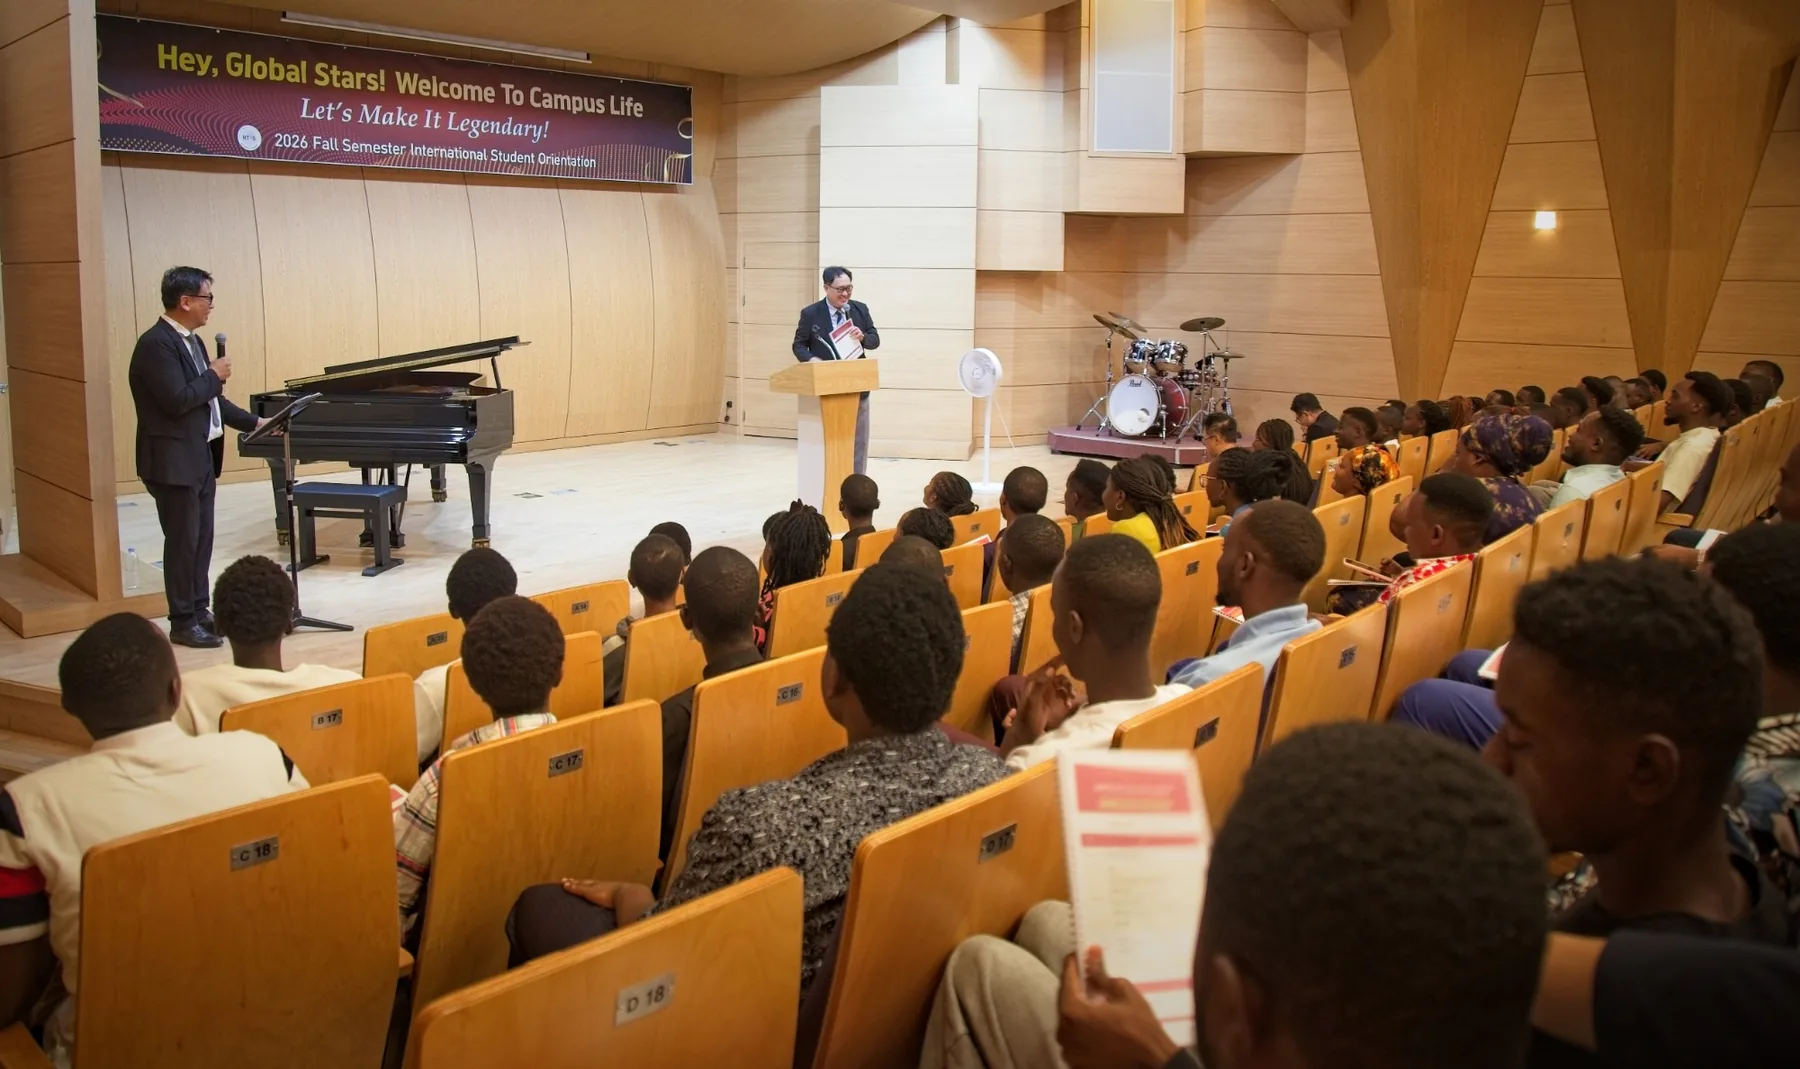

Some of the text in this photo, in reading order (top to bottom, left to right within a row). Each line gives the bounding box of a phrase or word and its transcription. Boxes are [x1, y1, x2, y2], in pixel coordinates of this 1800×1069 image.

[157, 43, 644, 118] Hey, Global Stars! Welcome To Campus Life
[300, 98, 550, 144] Let's Make It Legendary!
[274, 133, 597, 168] 2026 Fall Semester International Student Orientation
[781, 691, 788, 700] C
[317, 713, 338, 725] B 17
[555, 754, 578, 770] C 17
[240, 843, 271, 862] C 18
[626, 985, 665, 1014] D 18
